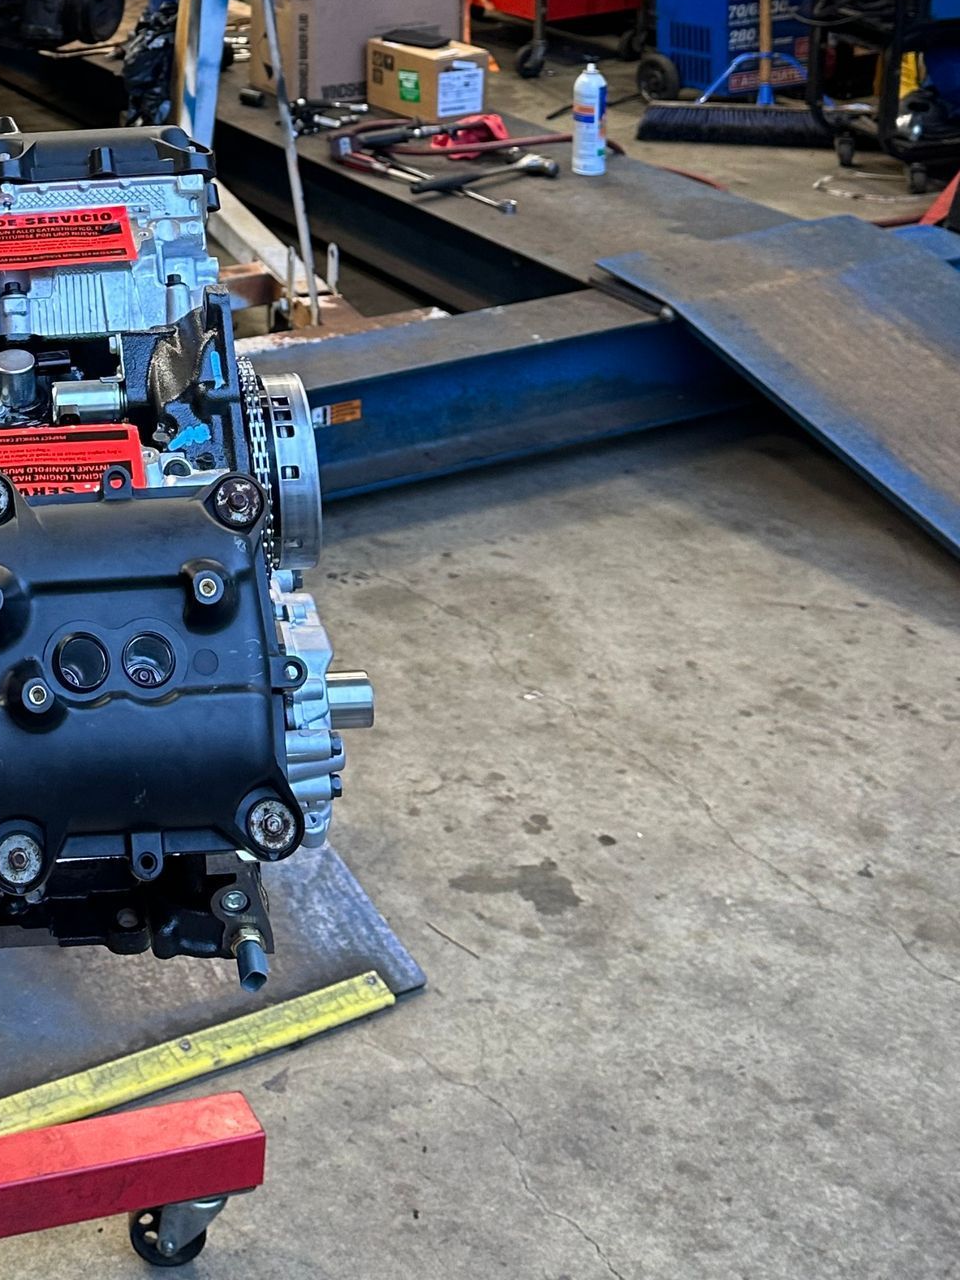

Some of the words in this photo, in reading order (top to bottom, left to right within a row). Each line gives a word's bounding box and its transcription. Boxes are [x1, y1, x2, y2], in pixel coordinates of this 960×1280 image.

[25, 212, 113, 225] SERVICIO
[26, 466, 75, 474] MANIFOLD
[76, 464, 110, 472] INTAKE
